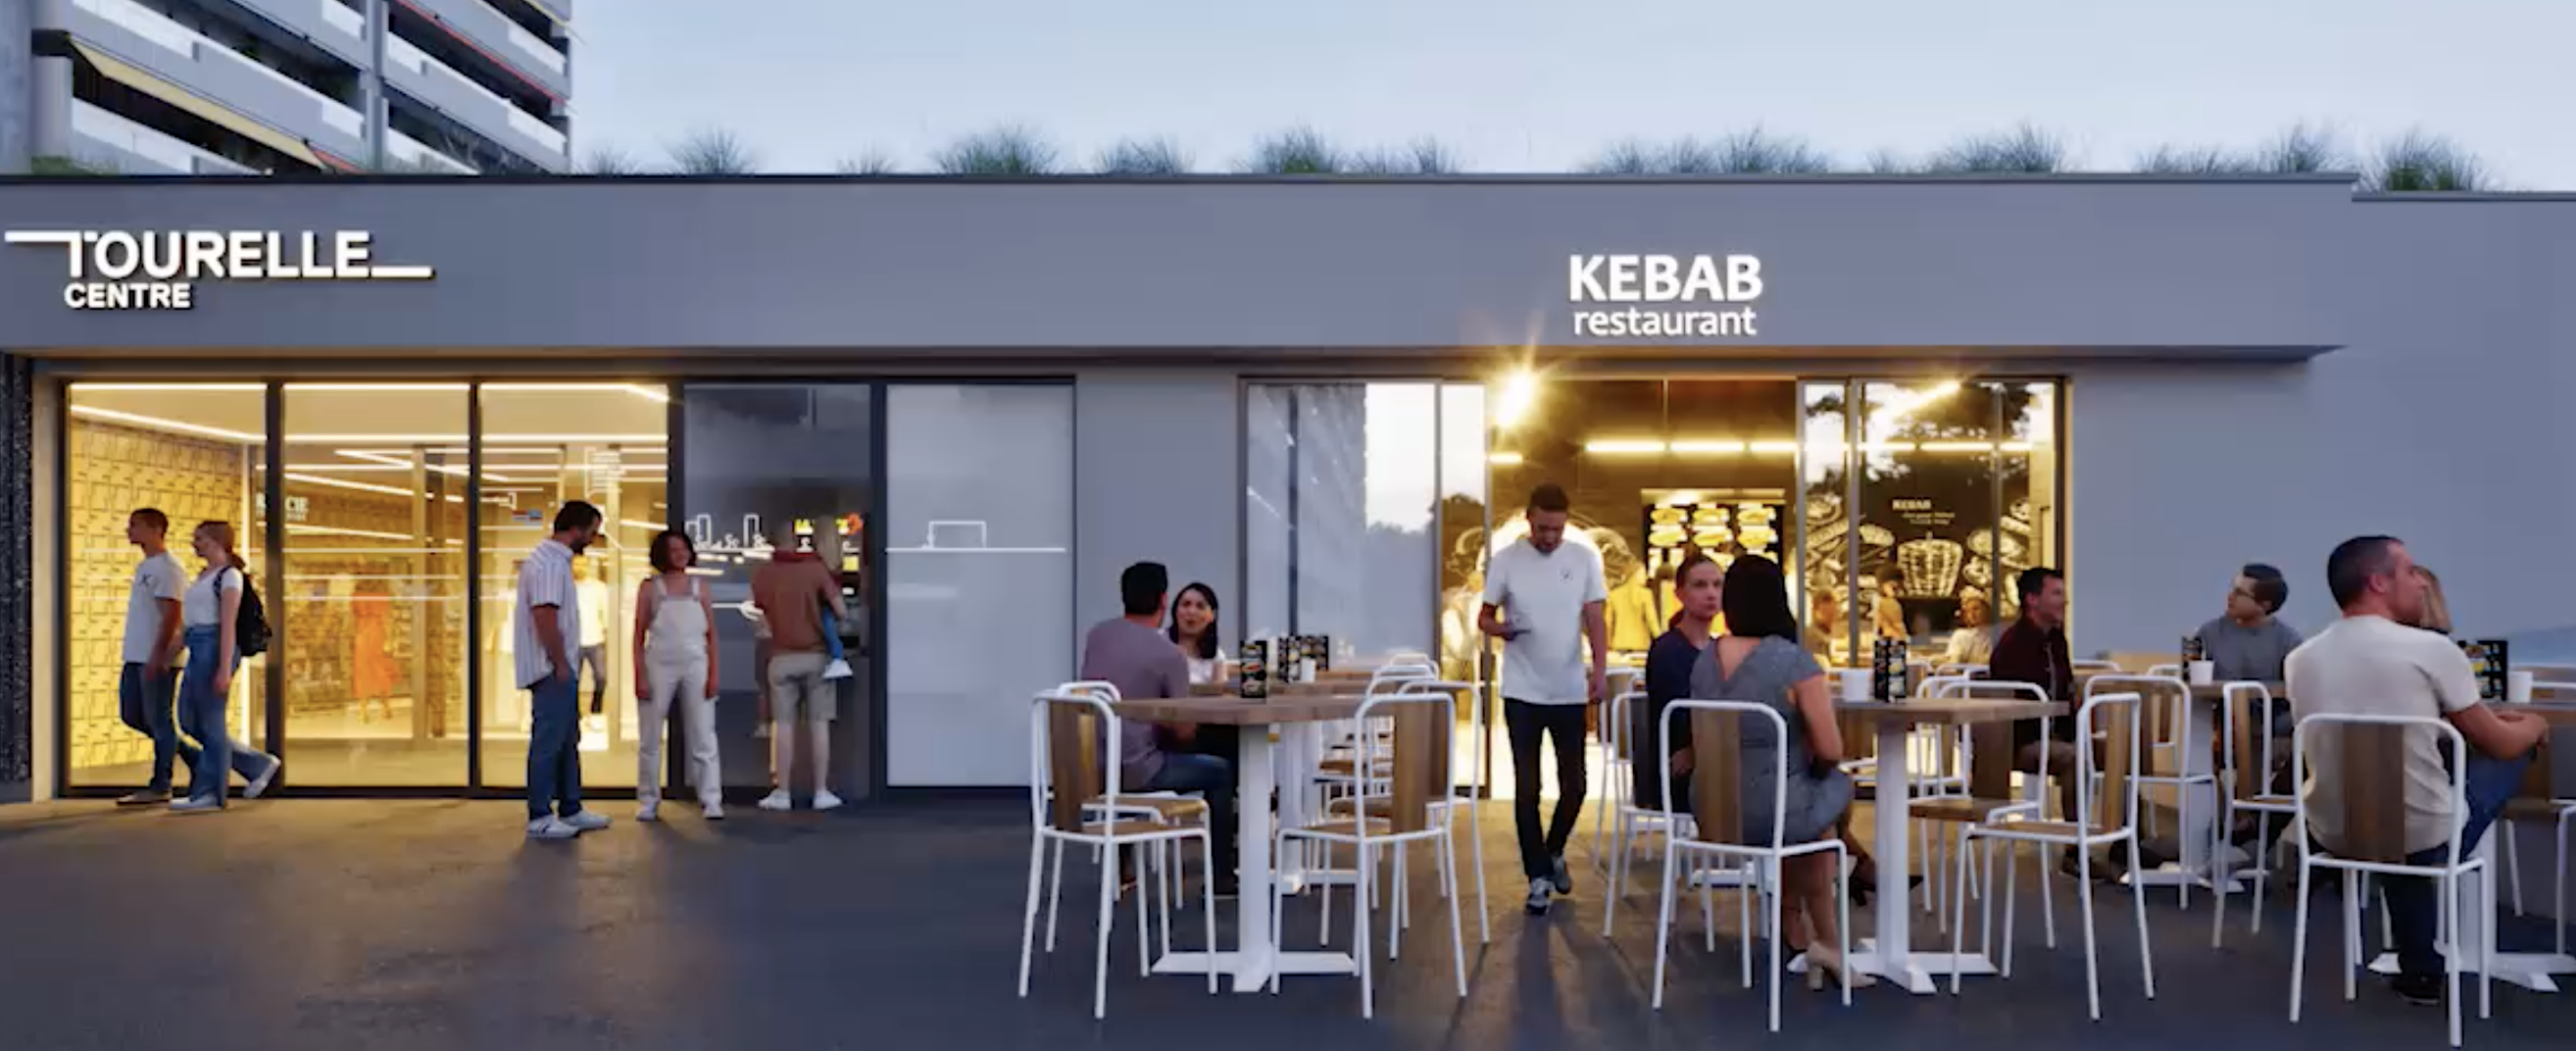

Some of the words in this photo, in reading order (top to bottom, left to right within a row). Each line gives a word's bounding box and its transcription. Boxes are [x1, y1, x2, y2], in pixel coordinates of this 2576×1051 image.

[5, 229, 371, 278] TOURELLE
[64, 282, 191, 309] CENTRE
[1569, 254, 1763, 302] KEBAB
[1573, 306, 1758, 336] restaurant
